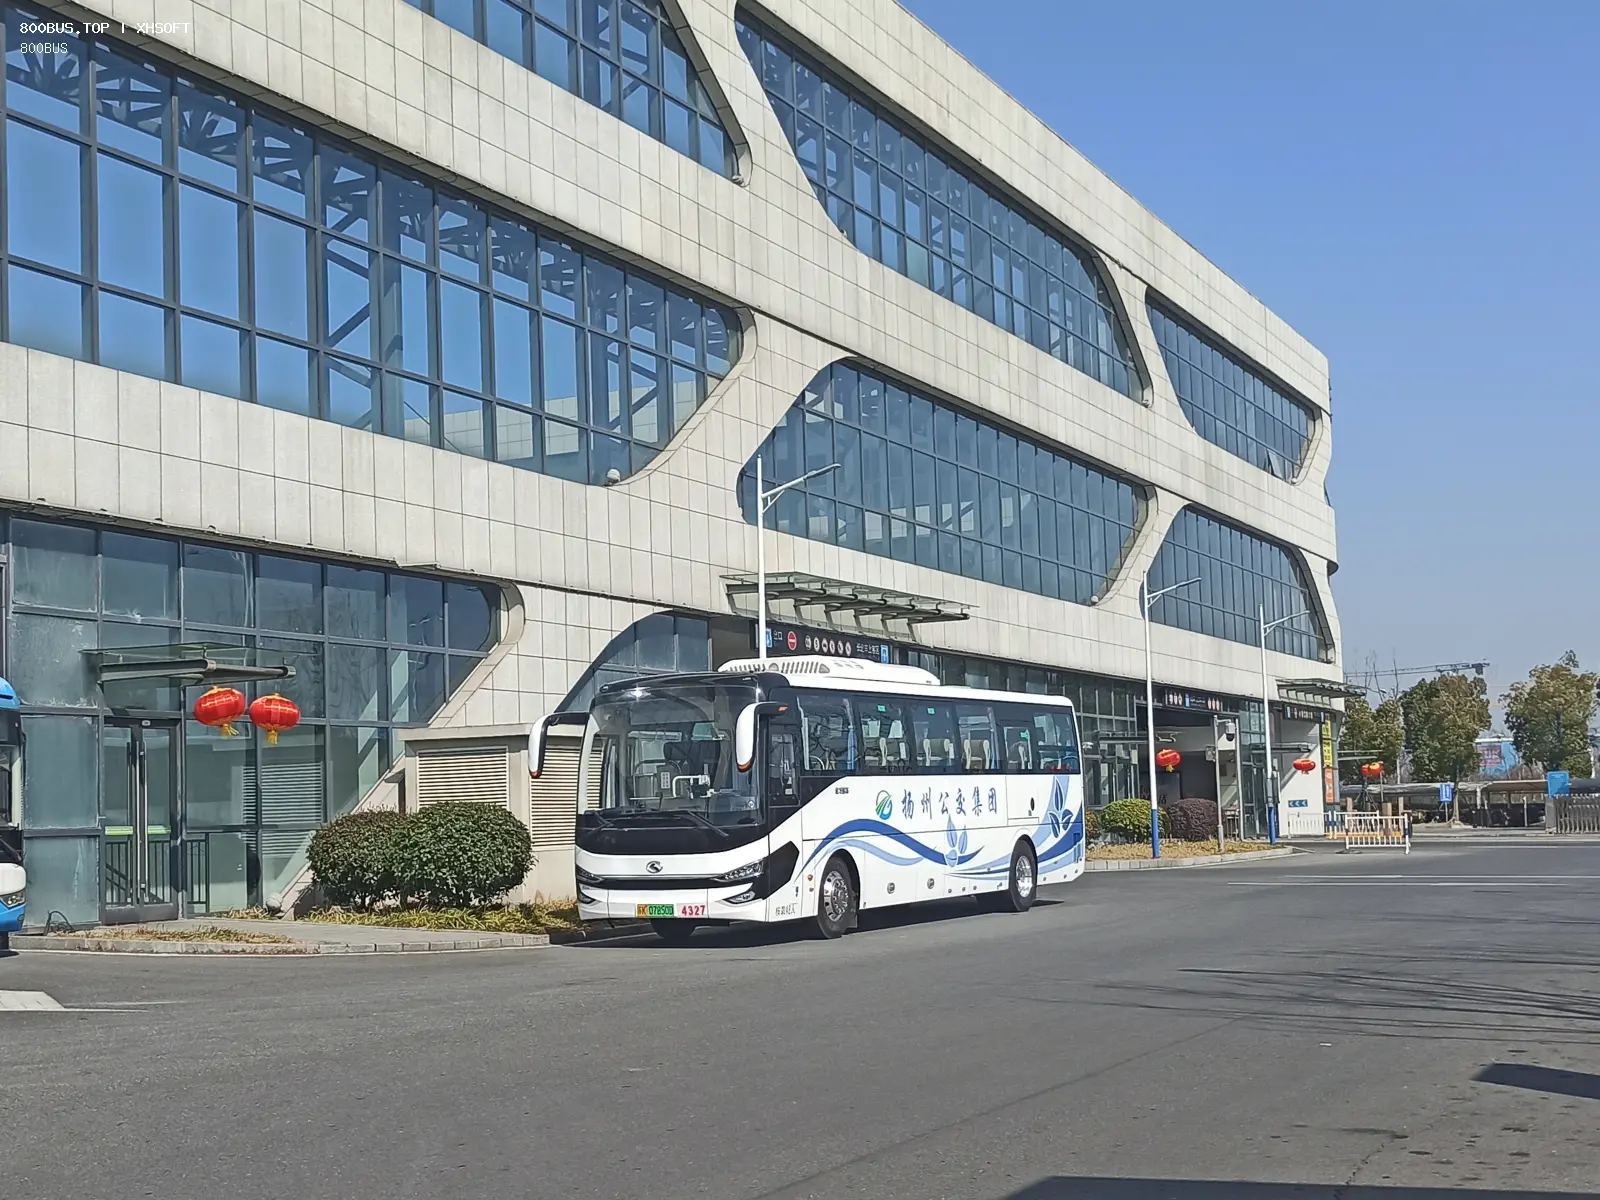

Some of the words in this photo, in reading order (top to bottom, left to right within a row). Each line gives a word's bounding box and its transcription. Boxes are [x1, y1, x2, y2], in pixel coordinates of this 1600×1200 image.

[901, 786, 998, 820] 扬州公交集团
[681, 905, 706, 916] 4327
